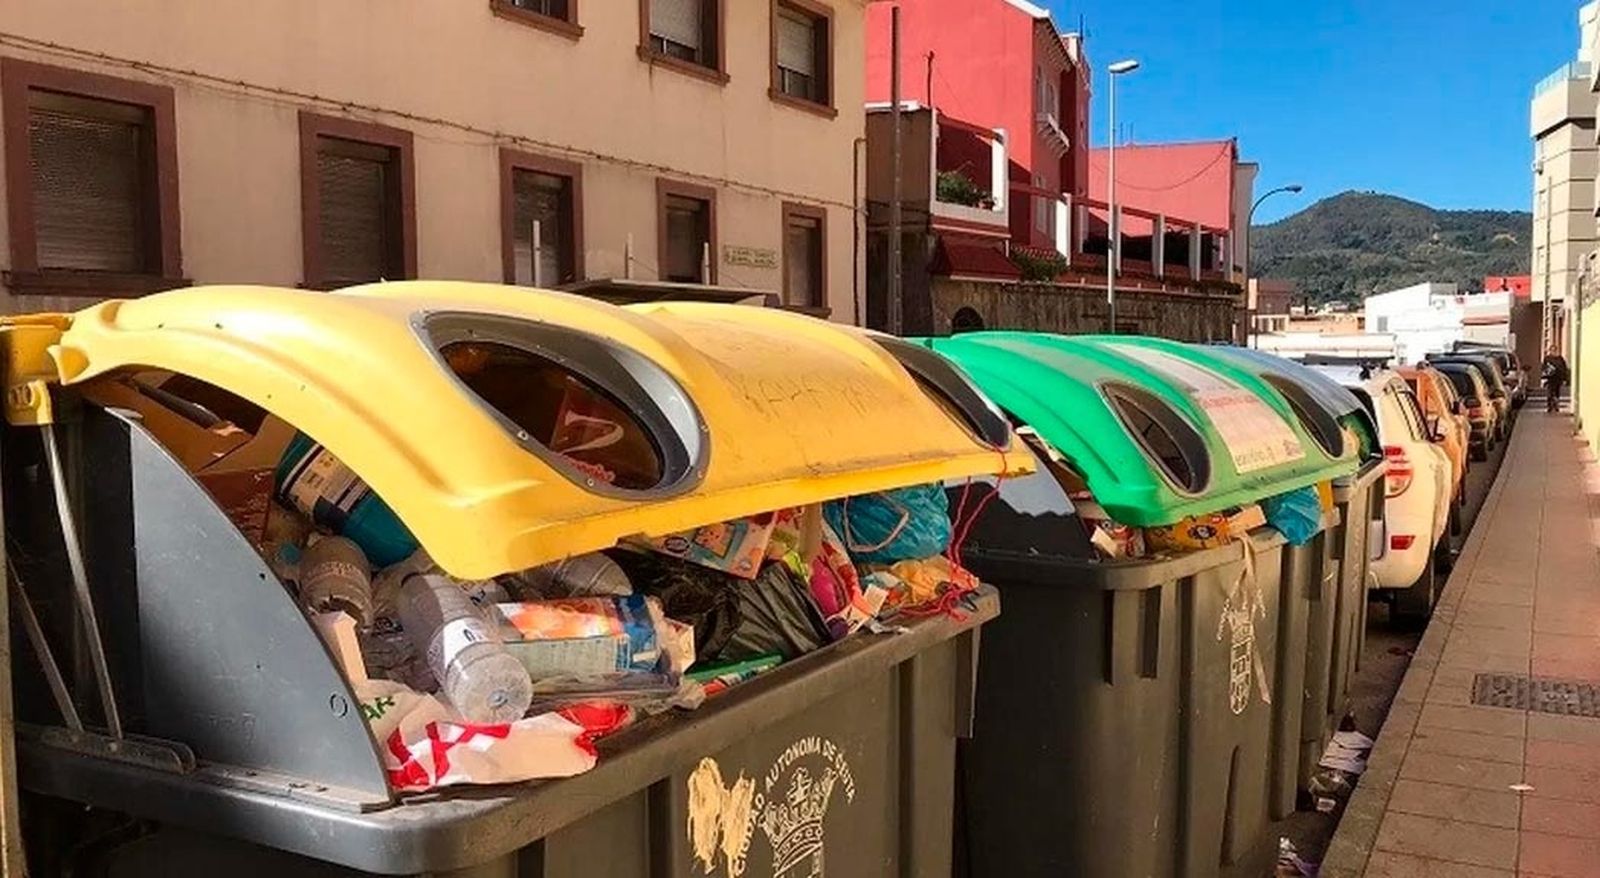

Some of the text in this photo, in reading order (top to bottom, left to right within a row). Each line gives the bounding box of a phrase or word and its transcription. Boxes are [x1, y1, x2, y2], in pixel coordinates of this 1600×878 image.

[735, 736, 856, 877] CIUDAD AUTONOMA DE CEUTA
